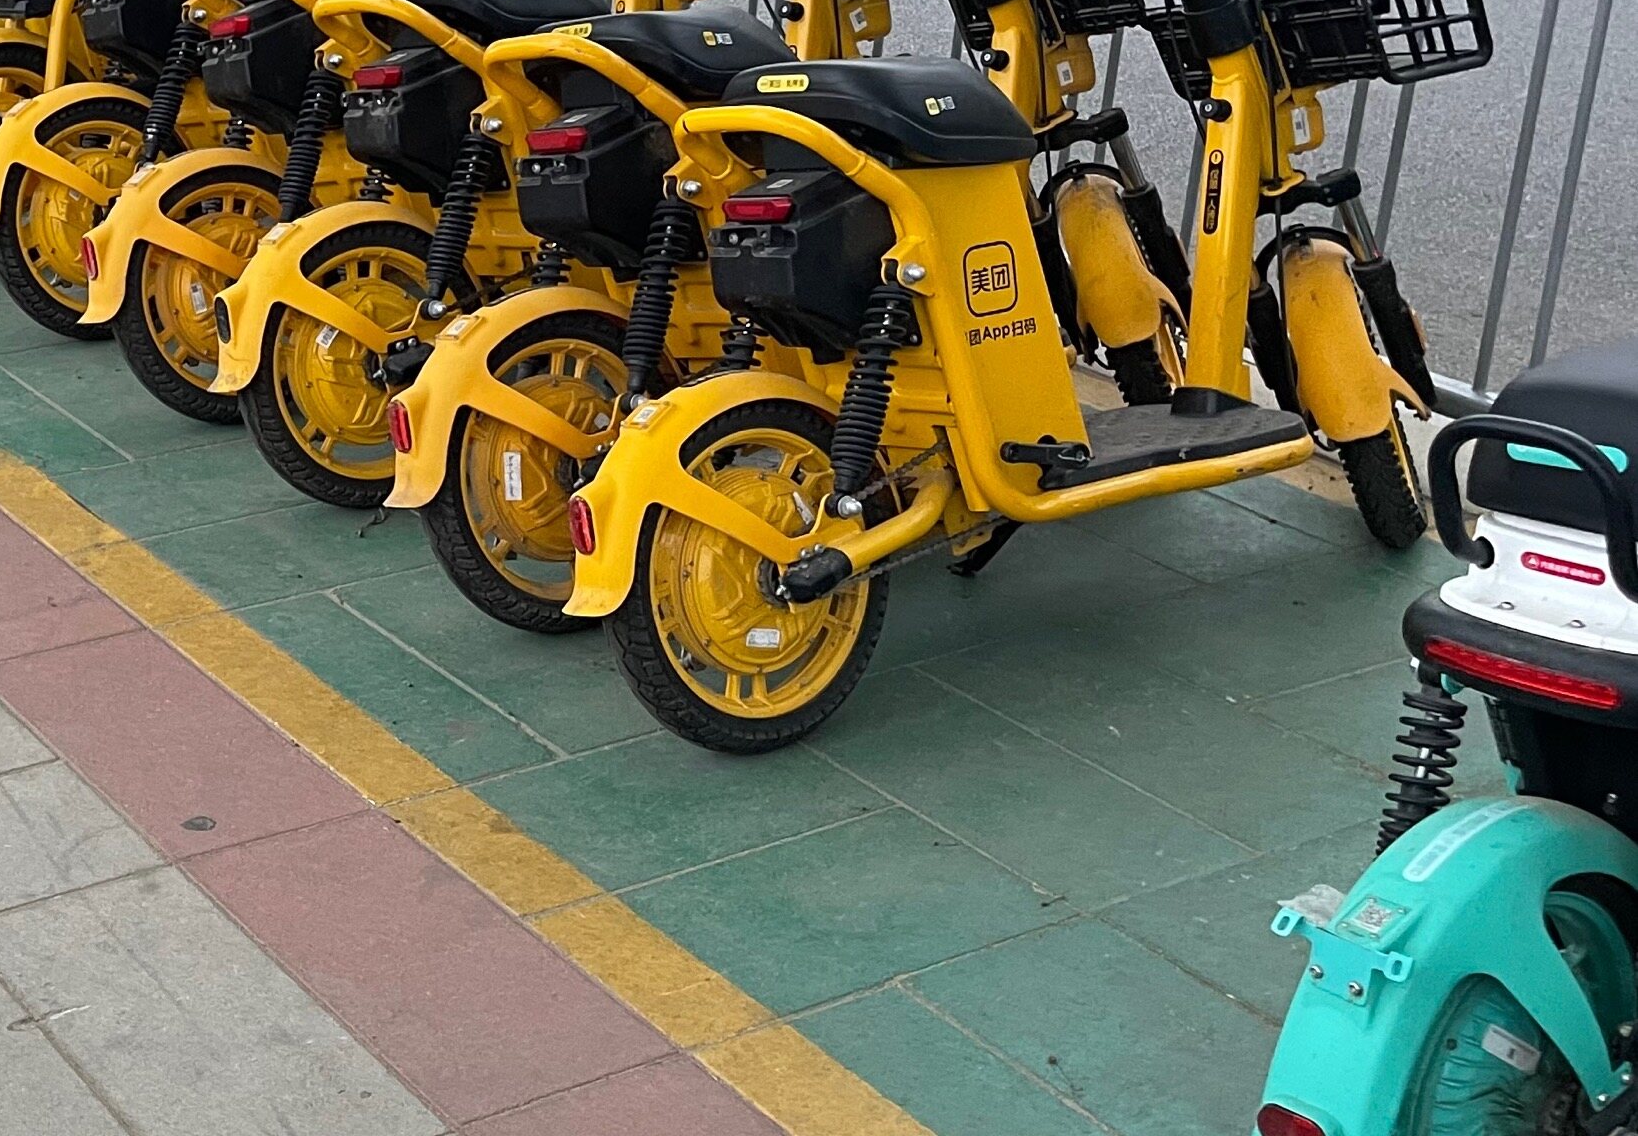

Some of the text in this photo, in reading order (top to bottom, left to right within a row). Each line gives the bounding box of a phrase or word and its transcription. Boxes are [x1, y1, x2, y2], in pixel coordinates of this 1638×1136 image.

[970, 263, 1011, 295] 美团
[965, 318, 1037, 347] 团App扫码
